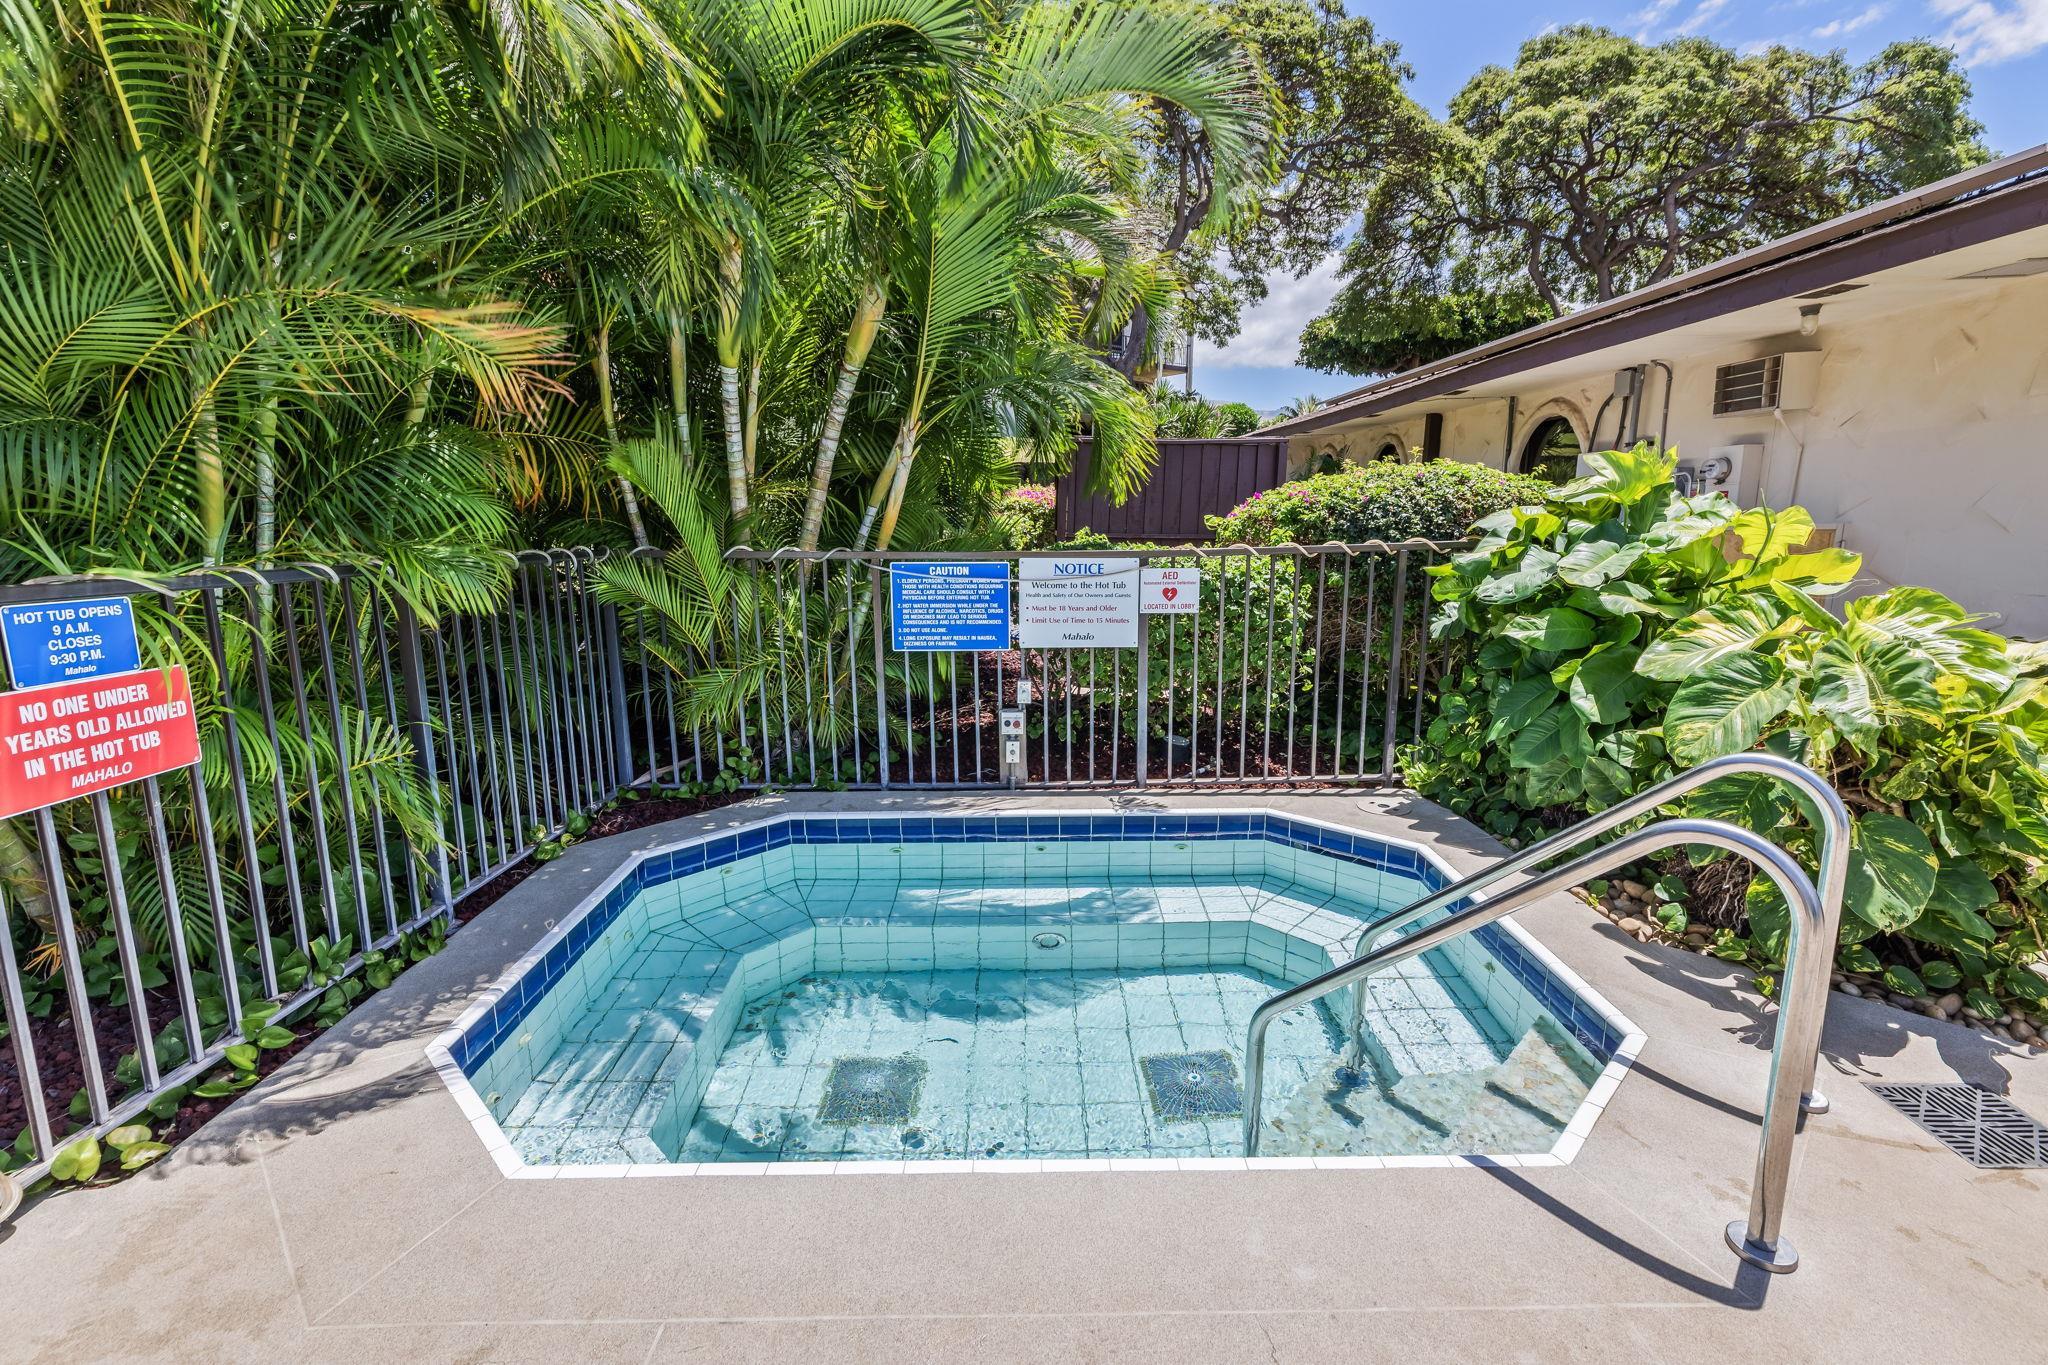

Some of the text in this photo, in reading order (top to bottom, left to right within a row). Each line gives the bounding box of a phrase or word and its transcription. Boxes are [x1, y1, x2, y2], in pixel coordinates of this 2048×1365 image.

[930, 566, 969, 575] CAUTION
[1054, 564, 1104, 574] NOTICE
[1162, 572, 1178, 580] AED
[14, 604, 122, 624] HOT TUB OPENS
[52, 622, 93, 636] 9 A.M.
[48, 634, 102, 651] CLOSES
[50, 649, 106, 666] 9:30 P.M.
[64, 665, 97, 676] Mahalo
[18, 684, 150, 724] NO ONE UNDER
[4, 700, 188, 755] YEARS OLD ALLOWED
[24, 730, 161, 780] IN THE HOT TUB
[72, 762, 133, 788] MAHALO
